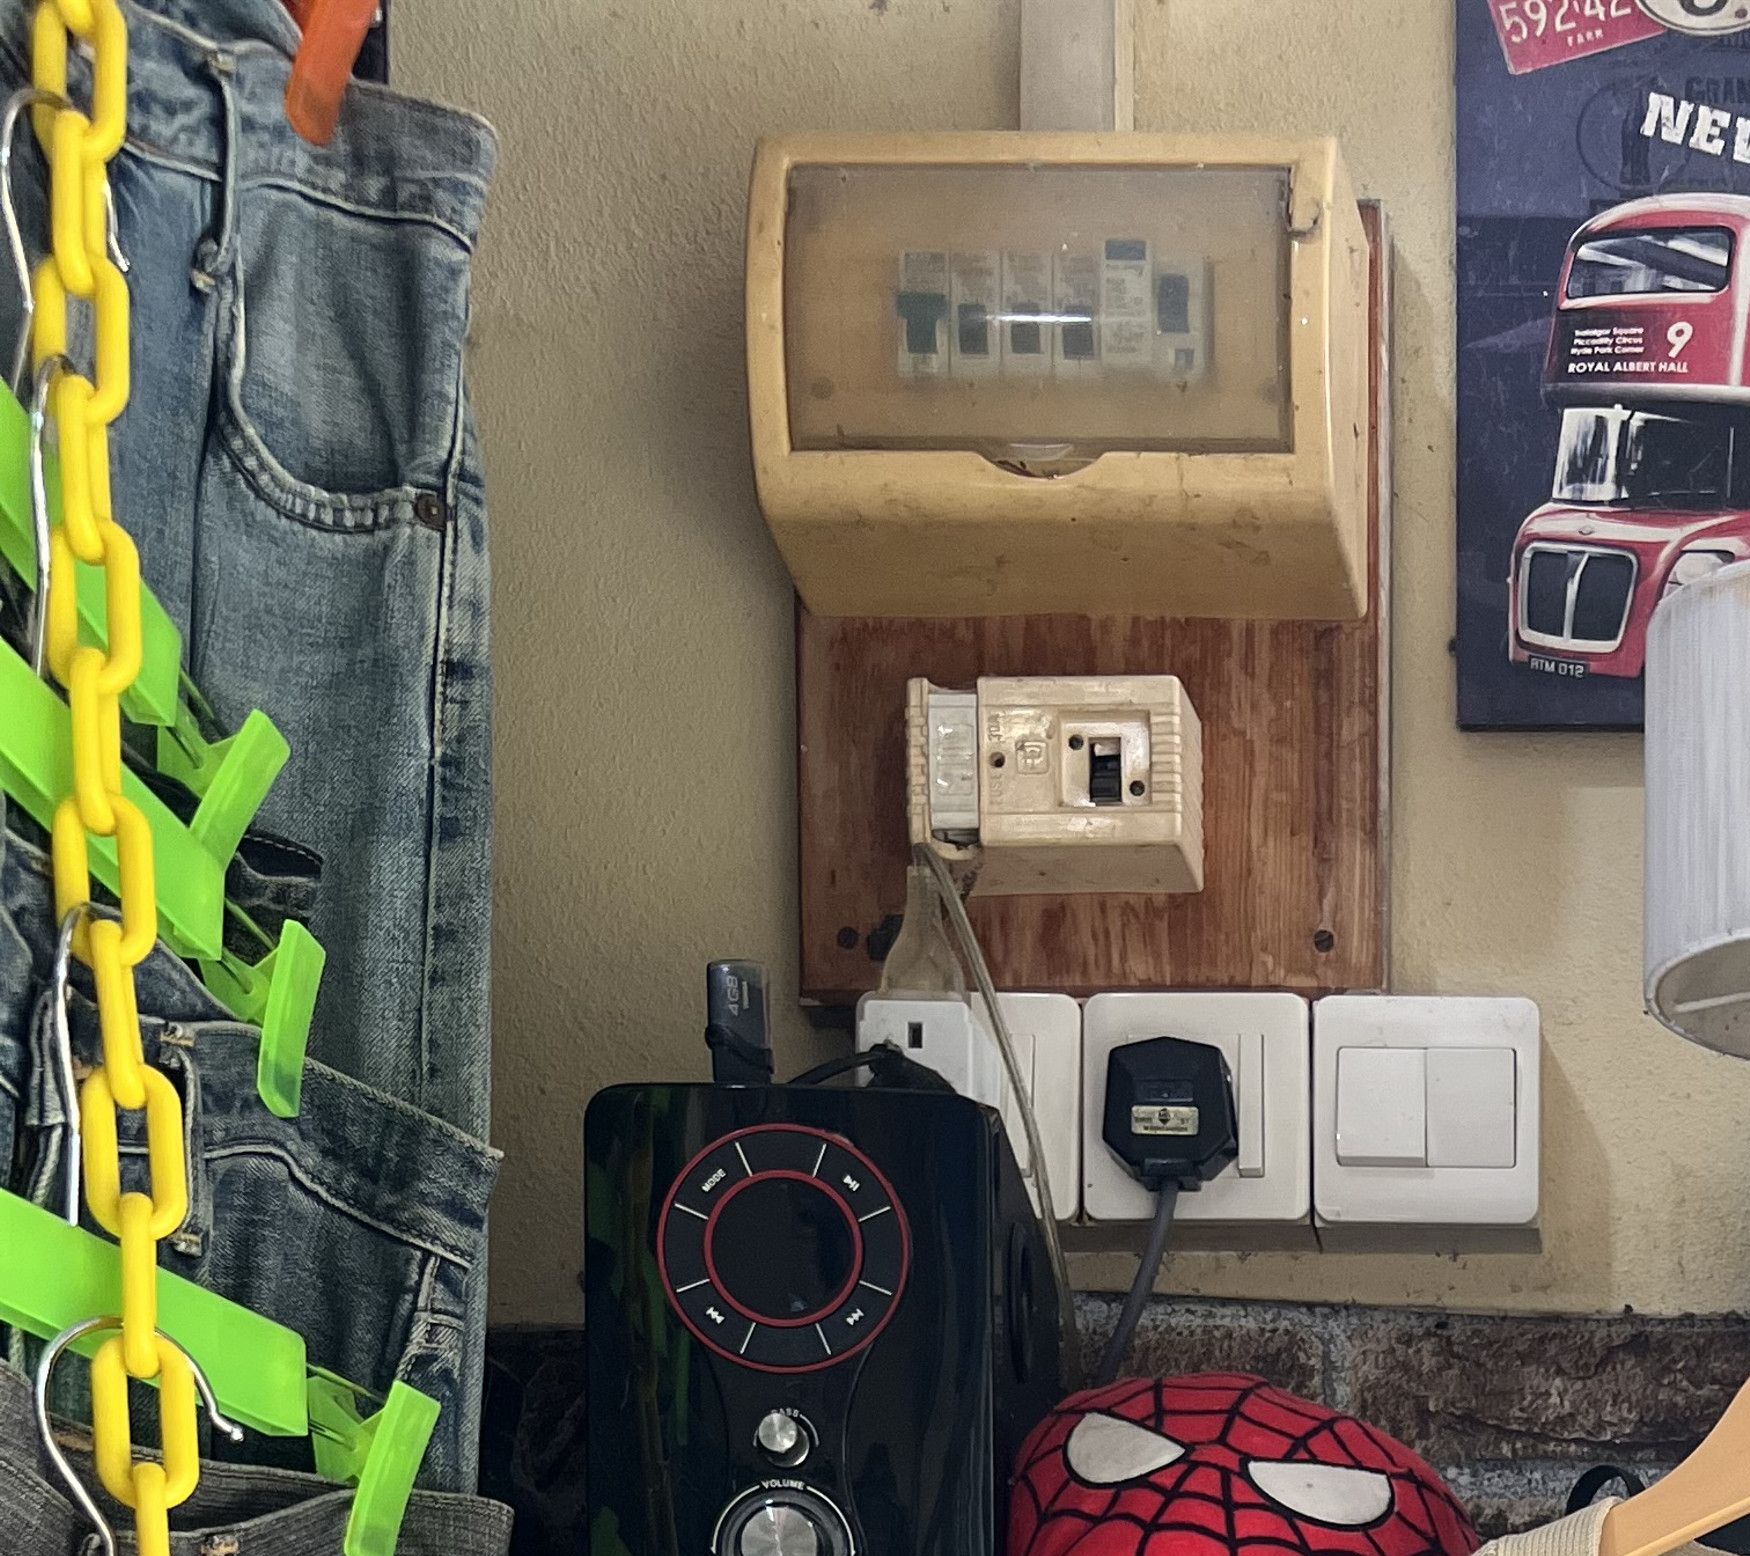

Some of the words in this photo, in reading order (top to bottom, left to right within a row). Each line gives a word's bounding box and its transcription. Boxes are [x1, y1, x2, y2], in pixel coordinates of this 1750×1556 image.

[1667, 321, 1693, 359] 9
[1567, 362, 1610, 373] ROYAL
[1613, 361, 1655, 373] ALBERT
[1658, 361, 1689, 373] HALL
[727, 975, 739, 1016] 4GB
[701, 1168, 727, 1192] MODE
[761, 1479, 805, 1490] VOLUME
